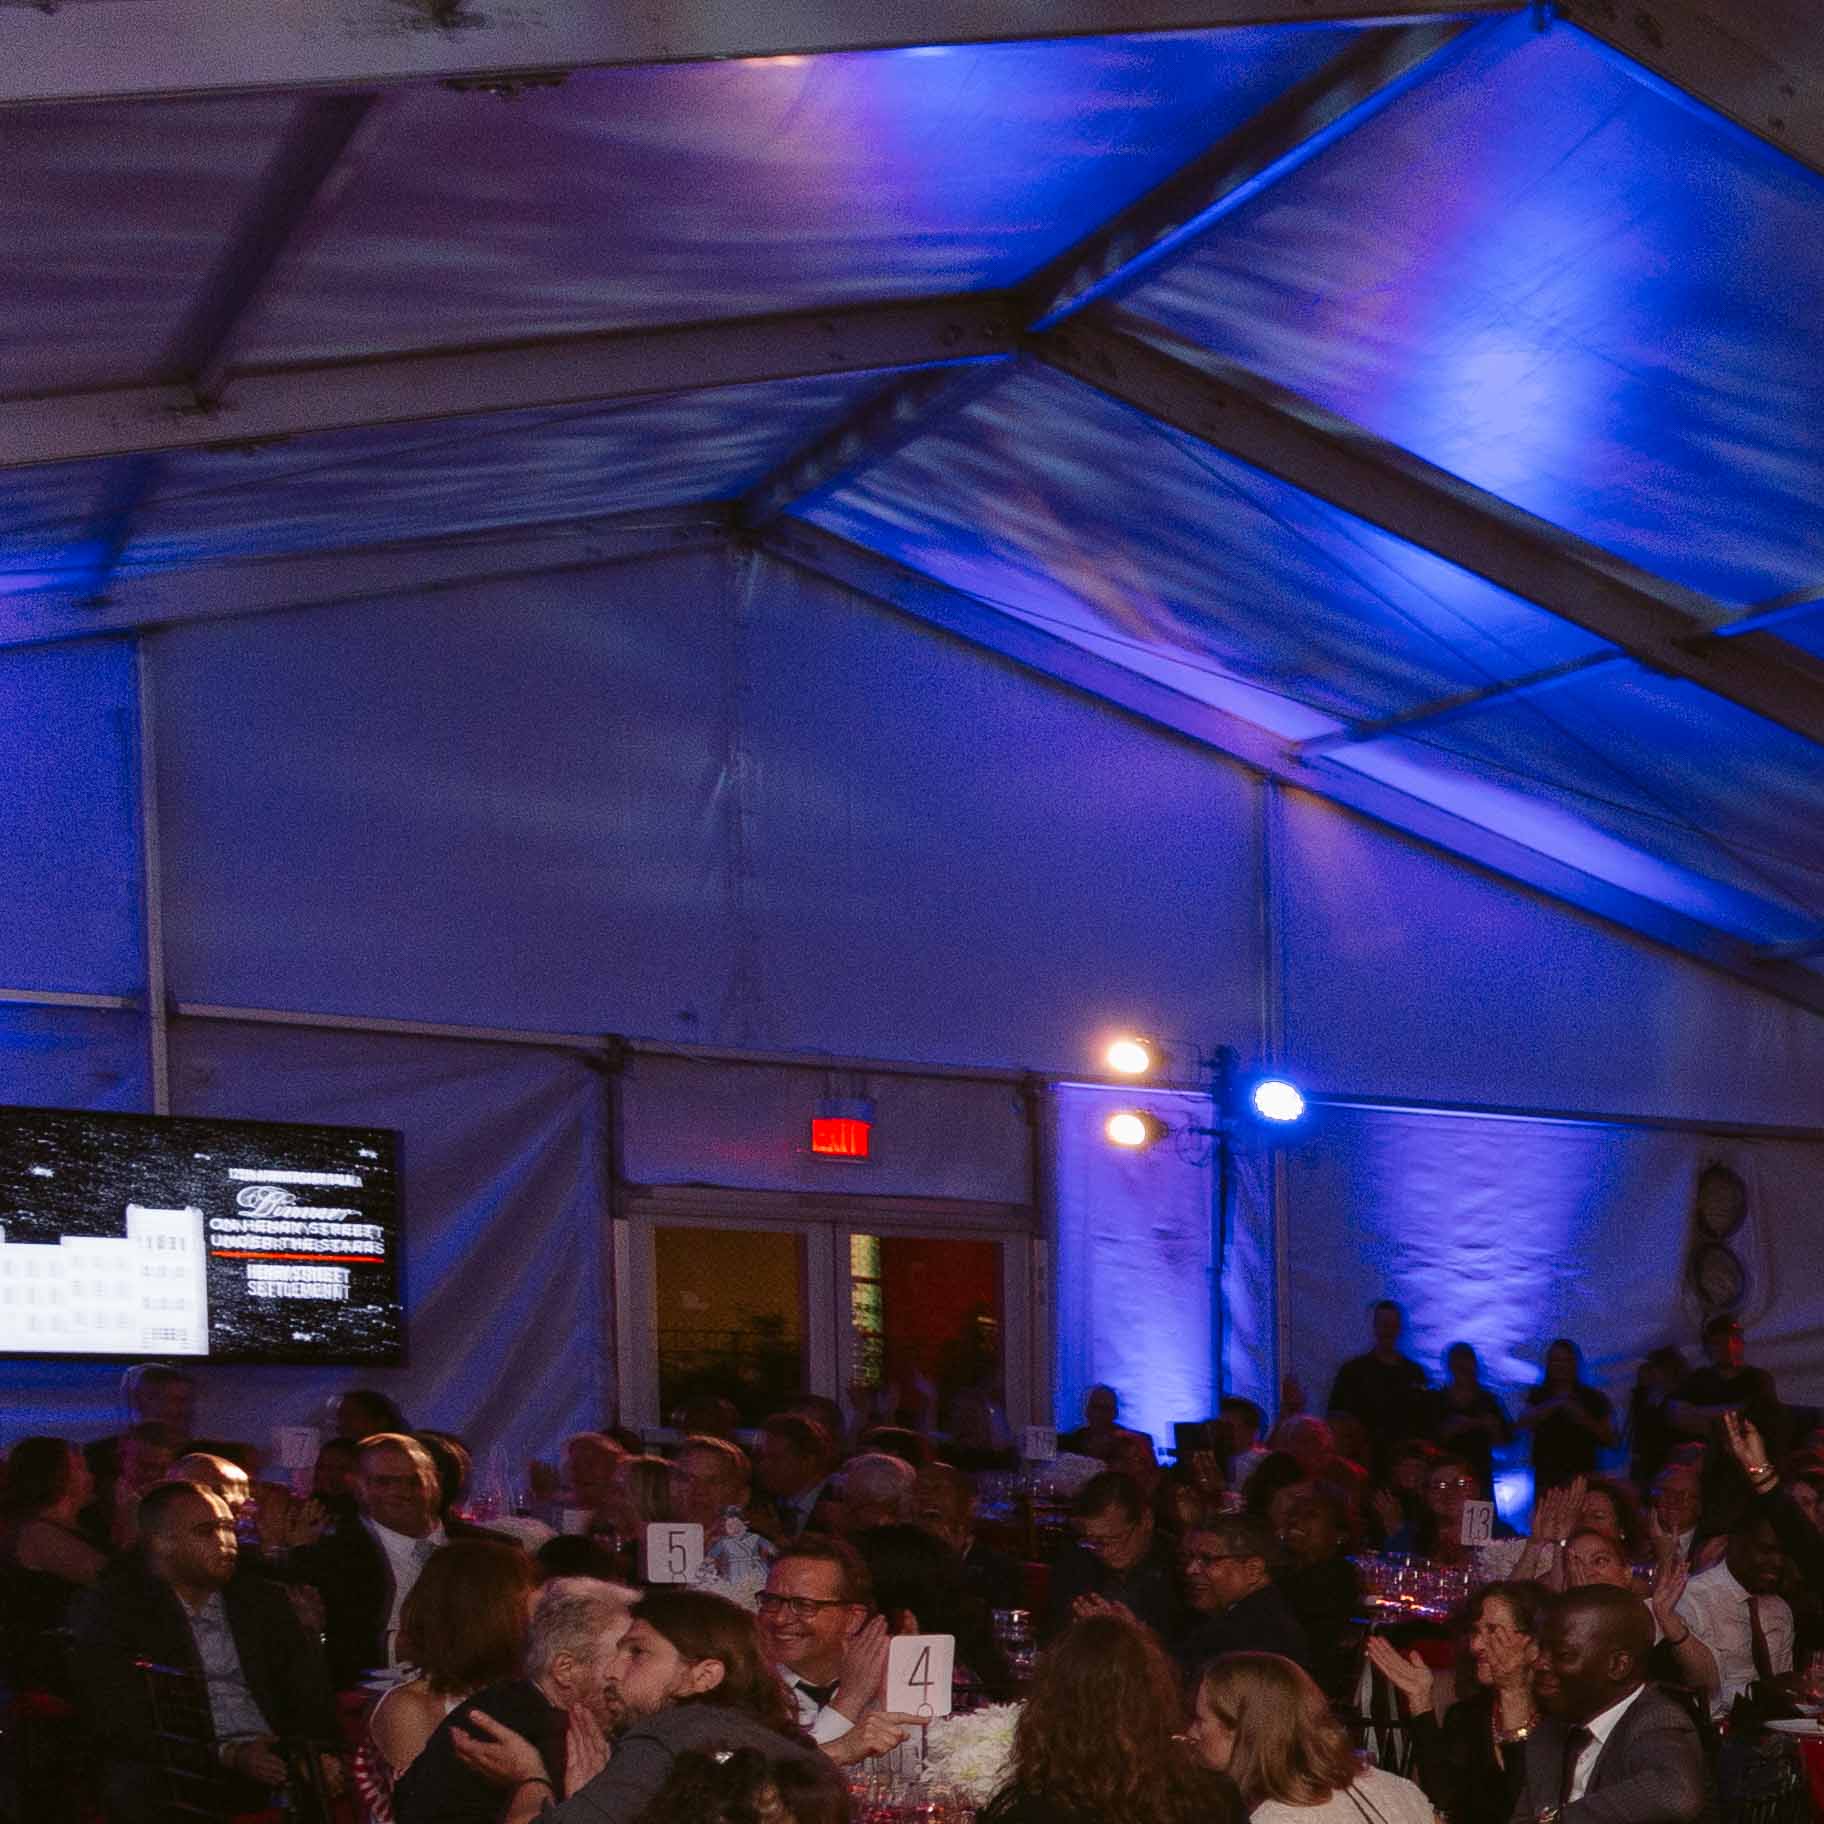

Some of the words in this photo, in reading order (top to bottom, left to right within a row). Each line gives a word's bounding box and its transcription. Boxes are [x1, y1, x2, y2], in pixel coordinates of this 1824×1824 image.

[1467, 1507, 1490, 1540] 13
[667, 1530, 687, 1576] 5
[907, 1645, 936, 1701] 4
